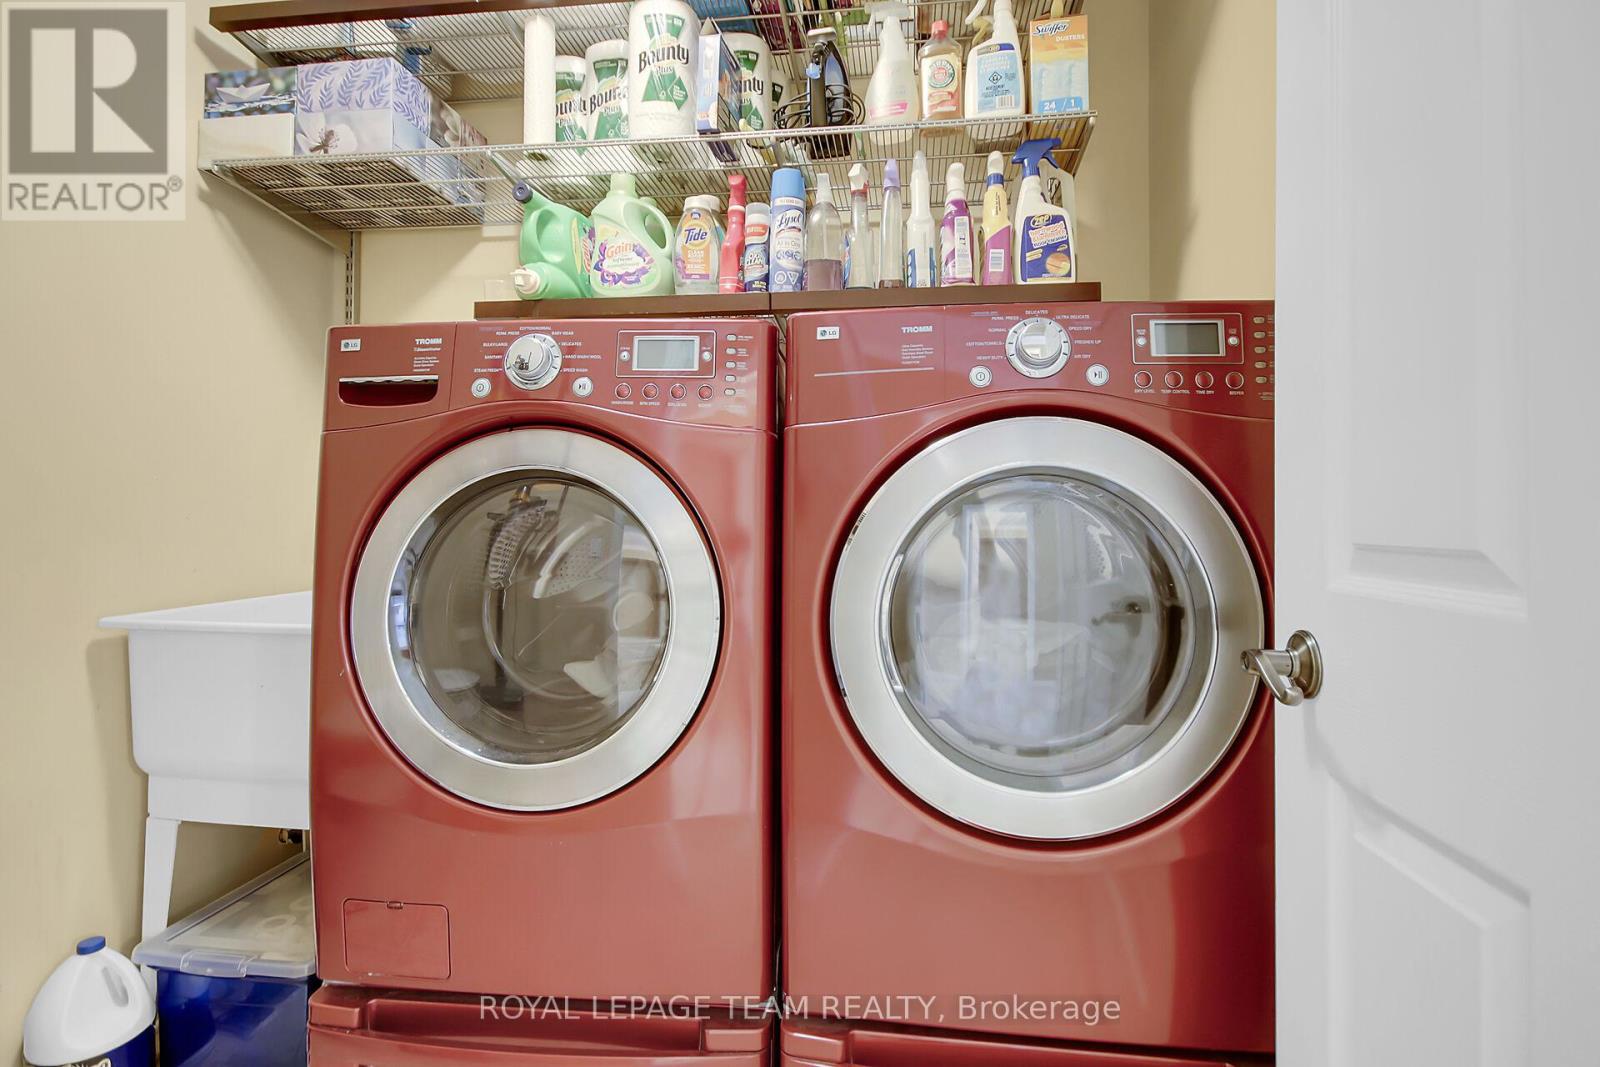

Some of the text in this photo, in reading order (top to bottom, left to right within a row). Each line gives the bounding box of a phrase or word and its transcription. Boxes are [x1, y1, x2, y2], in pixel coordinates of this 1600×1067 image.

[1033, 23, 1068, 34] Swiffer
[1055, 34, 1085, 42] DUSTERS
[638, 43, 690, 73] Bounty
[1044, 101, 1056, 111] 24
[777, 213, 801, 227] Lysol
[685, 228, 707, 245] Tide
[606, 241, 633, 259] Gain
